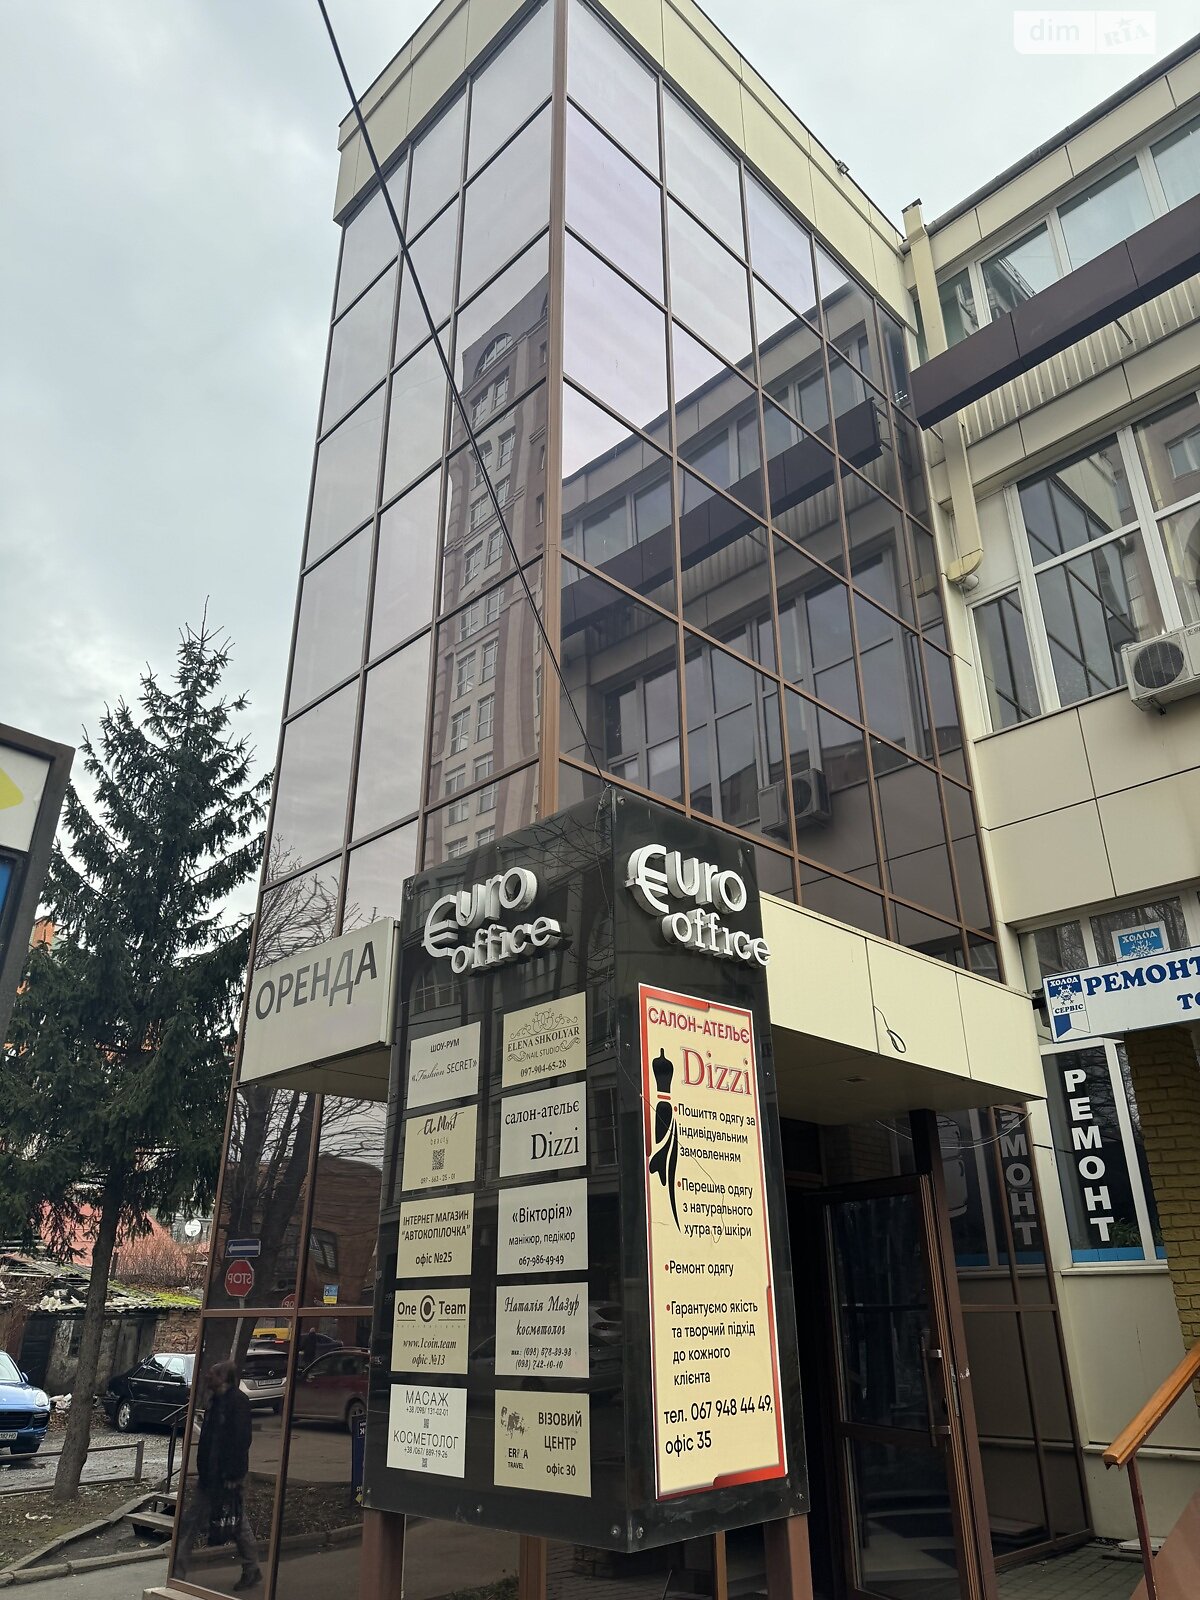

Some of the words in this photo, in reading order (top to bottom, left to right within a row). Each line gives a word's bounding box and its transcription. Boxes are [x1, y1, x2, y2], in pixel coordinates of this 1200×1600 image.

[661, 907, 771, 968] office
[1122, 930, 1157, 943] ХОЛОД
[451, 916, 561, 975] office
[255, 940, 378, 1020] ОРЕНДА
[1050, 976, 1079, 987] ХОЛОД
[1084, 956, 1200, 996] РЕМОНТ
[1054, 1003, 1084, 1014] СЕРВІС
[649, 1007, 750, 1043] САЛОН-АТЕЛЬЄ
[431, 1038, 460, 1053] ШОУ-РУМ
[507, 1039, 533, 1052] ELENA
[534, 1026, 580, 1045] SHKOLYAR
[540, 1046, 560, 1056] STUDIO
[446, 1058, 477, 1074] SECRET»
[520, 1059, 567, 1077] 097-904-65-28
[681, 1046, 752, 1095] Dizzi
[505, 1100, 580, 1125] салон-ательє
[678, 1103, 717, 1121] Пошиття
[719, 1111, 744, 1127] одягу
[746, 1115, 756, 1126] за
[678, 1123, 748, 1144] індивідуальним
[531, 1126, 579, 1160] Dizzi
[679, 1146, 741, 1163] замовленням
[1064, 1068, 1115, 1242] РЕМОНТ
[681, 1178, 725, 1195] Перешив
[728, 1184, 753, 1199] одягу
[402, 1213, 434, 1226] ІНТЕРНЕТ
[435, 1210, 469, 1223] МАГАЗИН
[512, 1203, 572, 1224] «Вікторія»
[682, 1202, 688, 1213] з
[690, 1203, 753, 1217] натурального
[508, 1234, 542, 1246] манікюр,
[543, 1231, 576, 1242] педікюр
[684, 1224, 710, 1238] хутра
[712, 1225, 722, 1236] та
[724, 1224, 752, 1239] шкіри
[415, 1253, 433, 1267] офіс
[434, 1251, 453, 1264] №25
[518, 1255, 564, 1266] 067-986-49-49
[669, 1260, 705, 1274] Ремонт
[707, 1263, 734, 1277] одягу
[397, 1302, 417, 1315] One
[439, 1301, 466, 1315] Team
[504, 1296, 544, 1312] Наталія
[547, 1294, 580, 1316] Мазур
[671, 1301, 727, 1318] Гарантуємо
[729, 1299, 758, 1313] якість
[516, 1319, 566, 1336] косметолог
[671, 1326, 682, 1338] та
[684, 1322, 725, 1340] творчий
[727, 1321, 756, 1337] підхід
[403, 1338, 457, 1349] www.1coin.team
[411, 1353, 428, 1367] офіс
[672, 1350, 686, 1364] до
[688, 1346, 731, 1361] кожного
[673, 1370, 711, 1386] клієнта
[405, 1390, 449, 1407] МАСАЖ
[664, 1408, 688, 1424] тел.
[690, 1401, 712, 1420] 067
[715, 1398, 737, 1418] 948
[740, 1396, 755, 1414] 44
[757, 1394, 773, 1414] 49,
[538, 1410, 582, 1427] ВІЗОВИЙ
[393, 1430, 459, 1449] КОСМЕТОЛОГ
[544, 1435, 577, 1451] ЦЕНТР
[665, 1434, 694, 1457] офіс
[696, 1430, 712, 1449] 35
[507, 1461, 524, 1470] TRAVEL
[546, 1463, 564, 1476] офіс
[566, 1464, 576, 1476] 30
